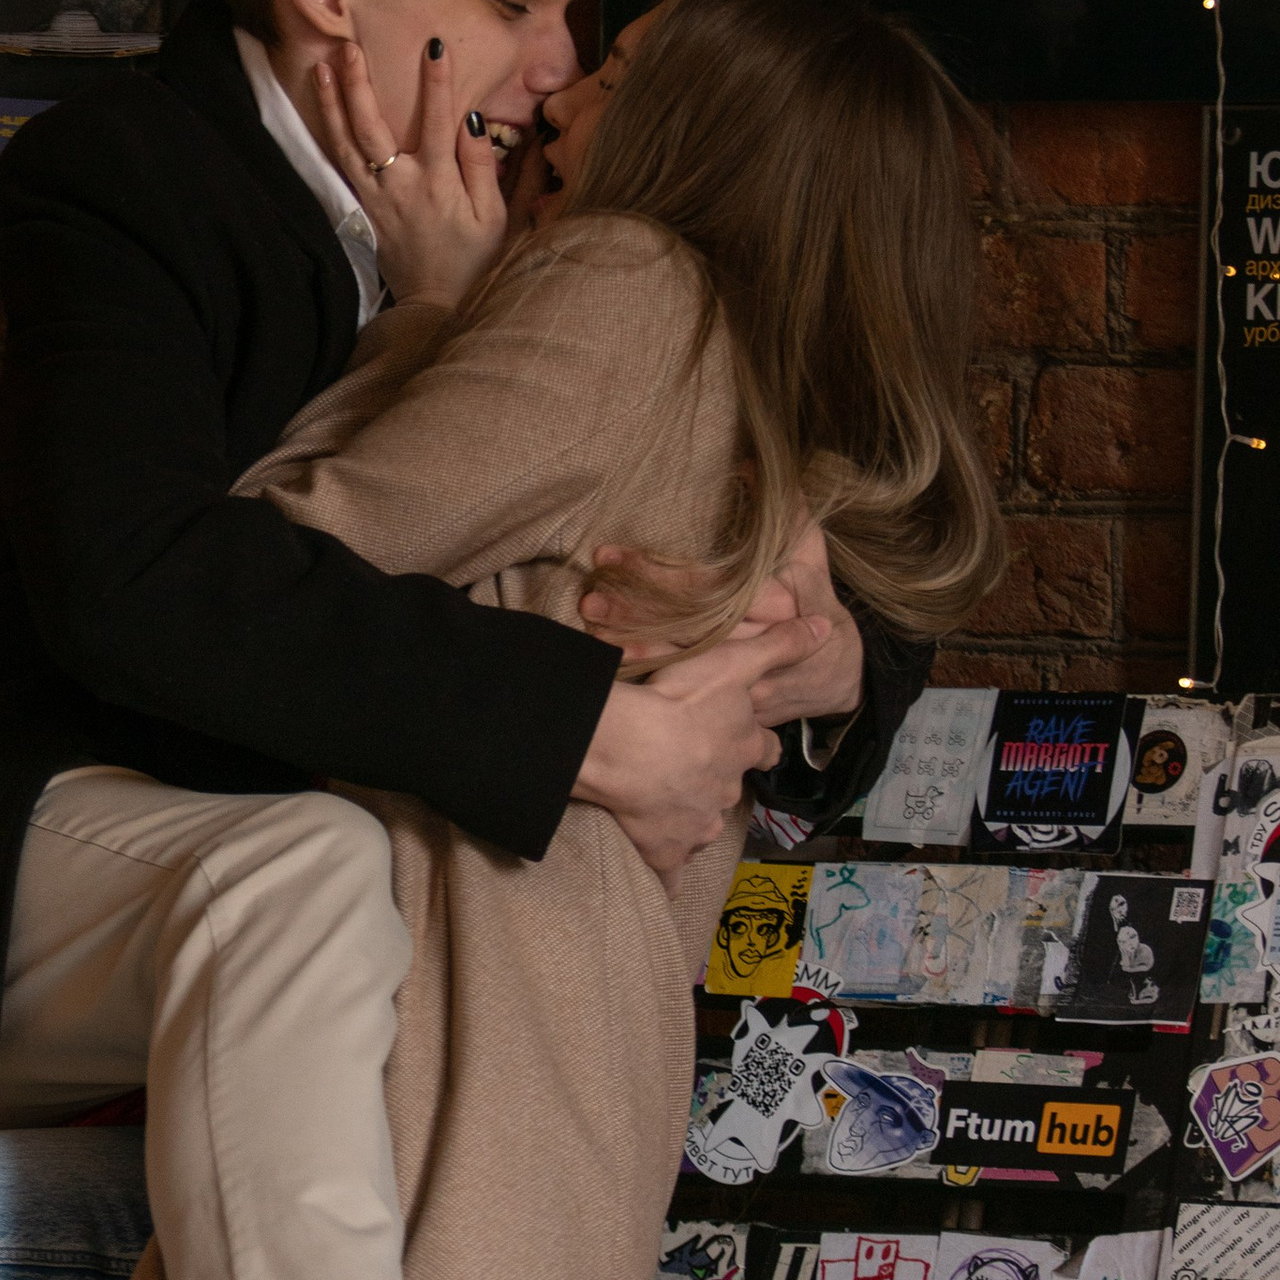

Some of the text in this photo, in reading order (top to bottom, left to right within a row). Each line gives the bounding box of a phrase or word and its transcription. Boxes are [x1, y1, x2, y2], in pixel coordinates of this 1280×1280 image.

[1024, 714, 1097, 745] RAVE
[999, 741, 1110, 773] MARGOTT
[1004, 763, 1108, 806] AGENT
[1046, 1112, 1115, 1147] hub
